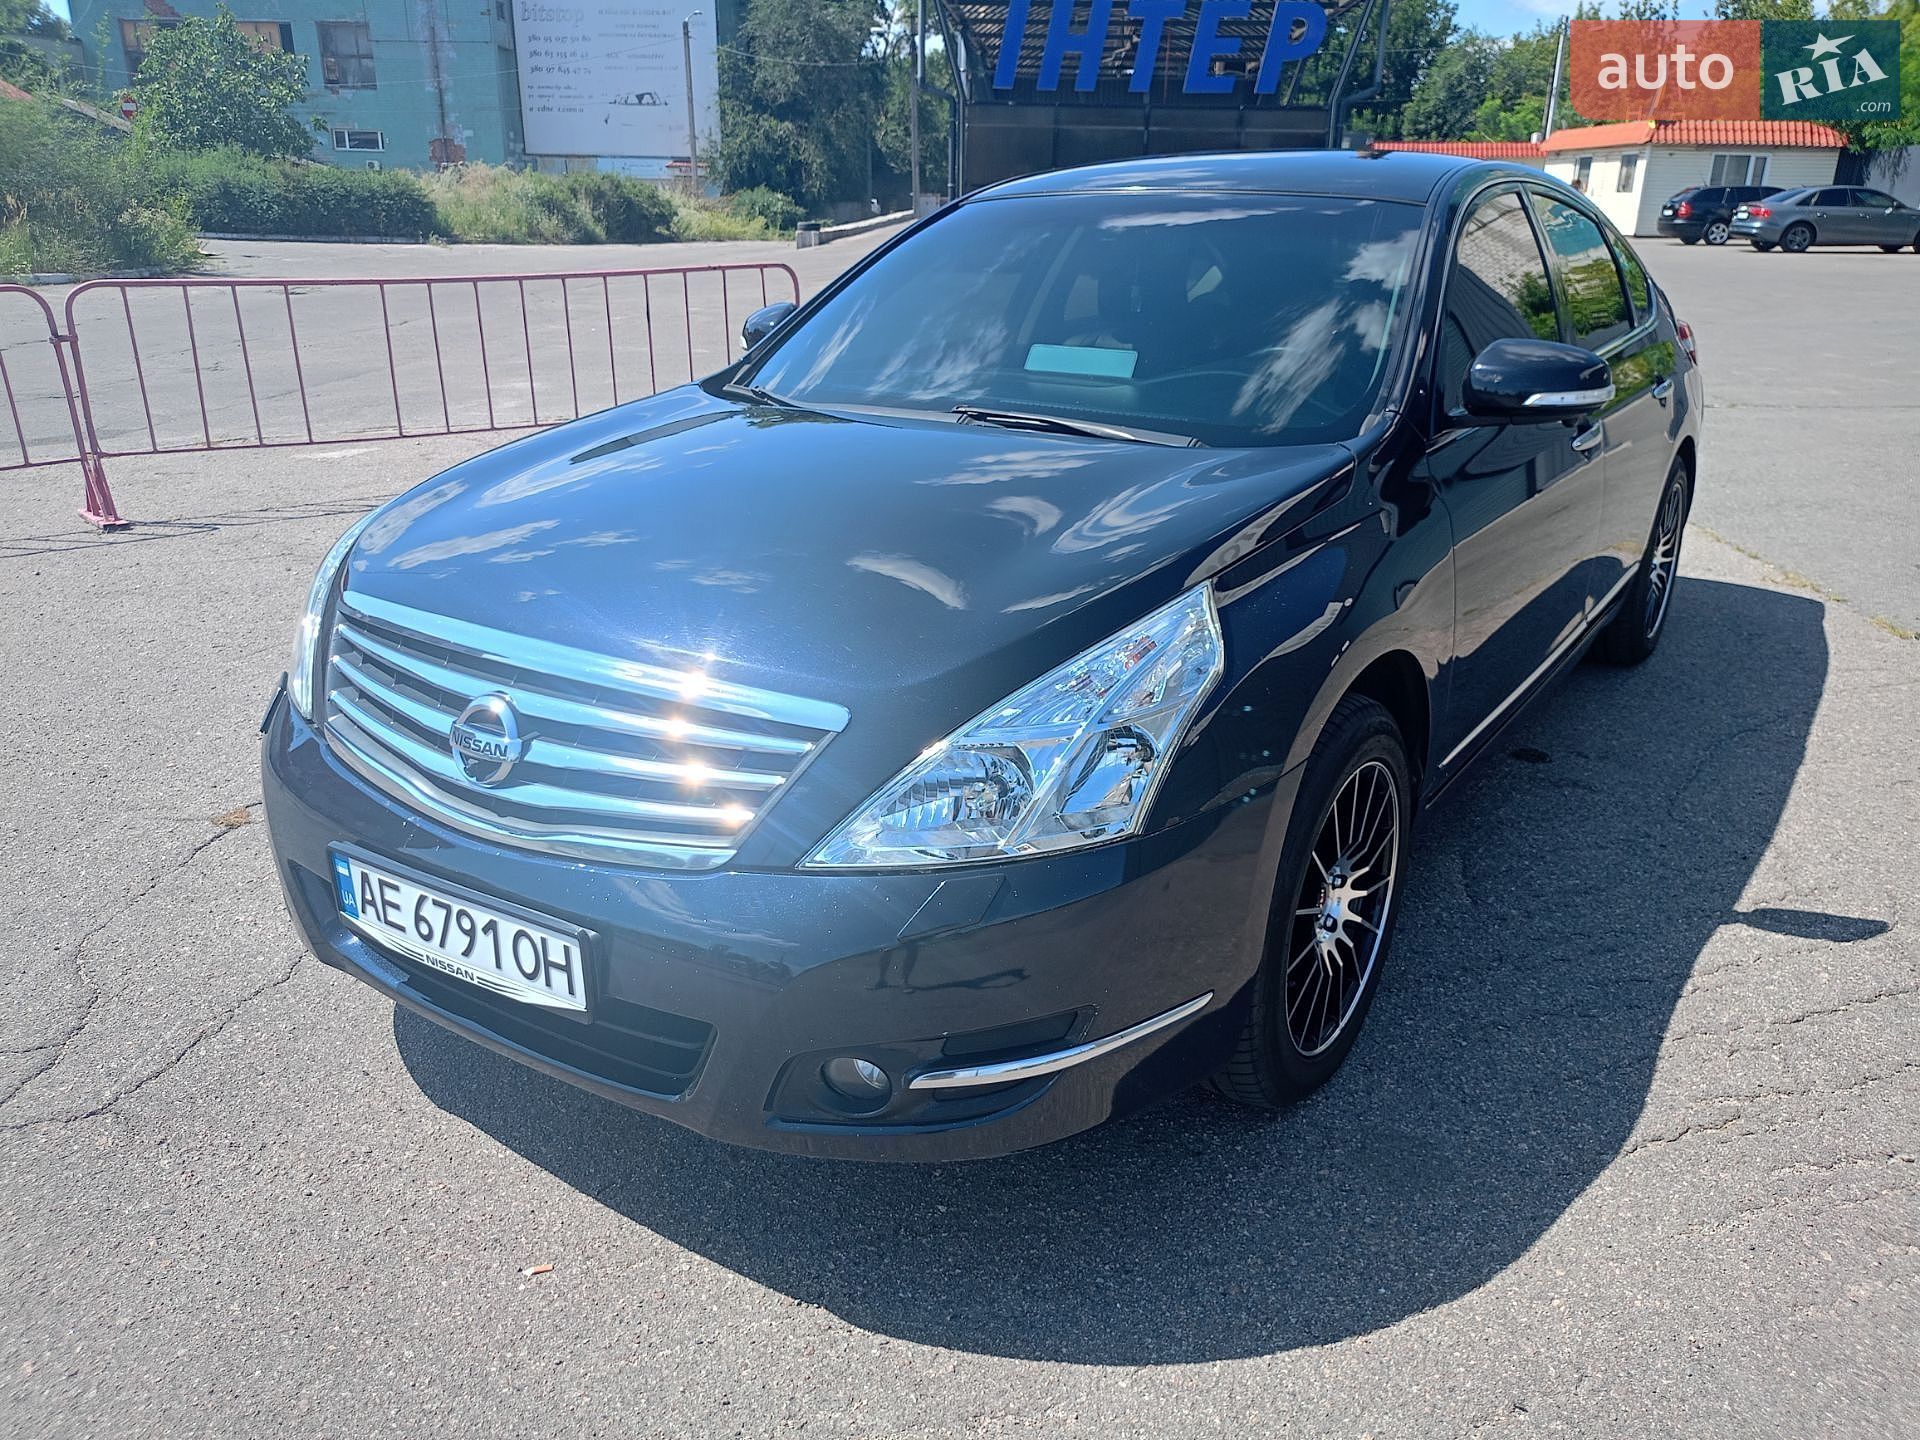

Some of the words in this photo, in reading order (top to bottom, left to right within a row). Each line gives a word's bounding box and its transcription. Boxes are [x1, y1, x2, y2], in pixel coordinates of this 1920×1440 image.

[453, 731, 508, 757] NISSAN
[341, 893, 357, 907] UA
[360, 871, 406, 934] AE
[413, 894, 503, 970] 6791
[512, 928, 576, 996] OH
[425, 953, 476, 982] NISSAN
